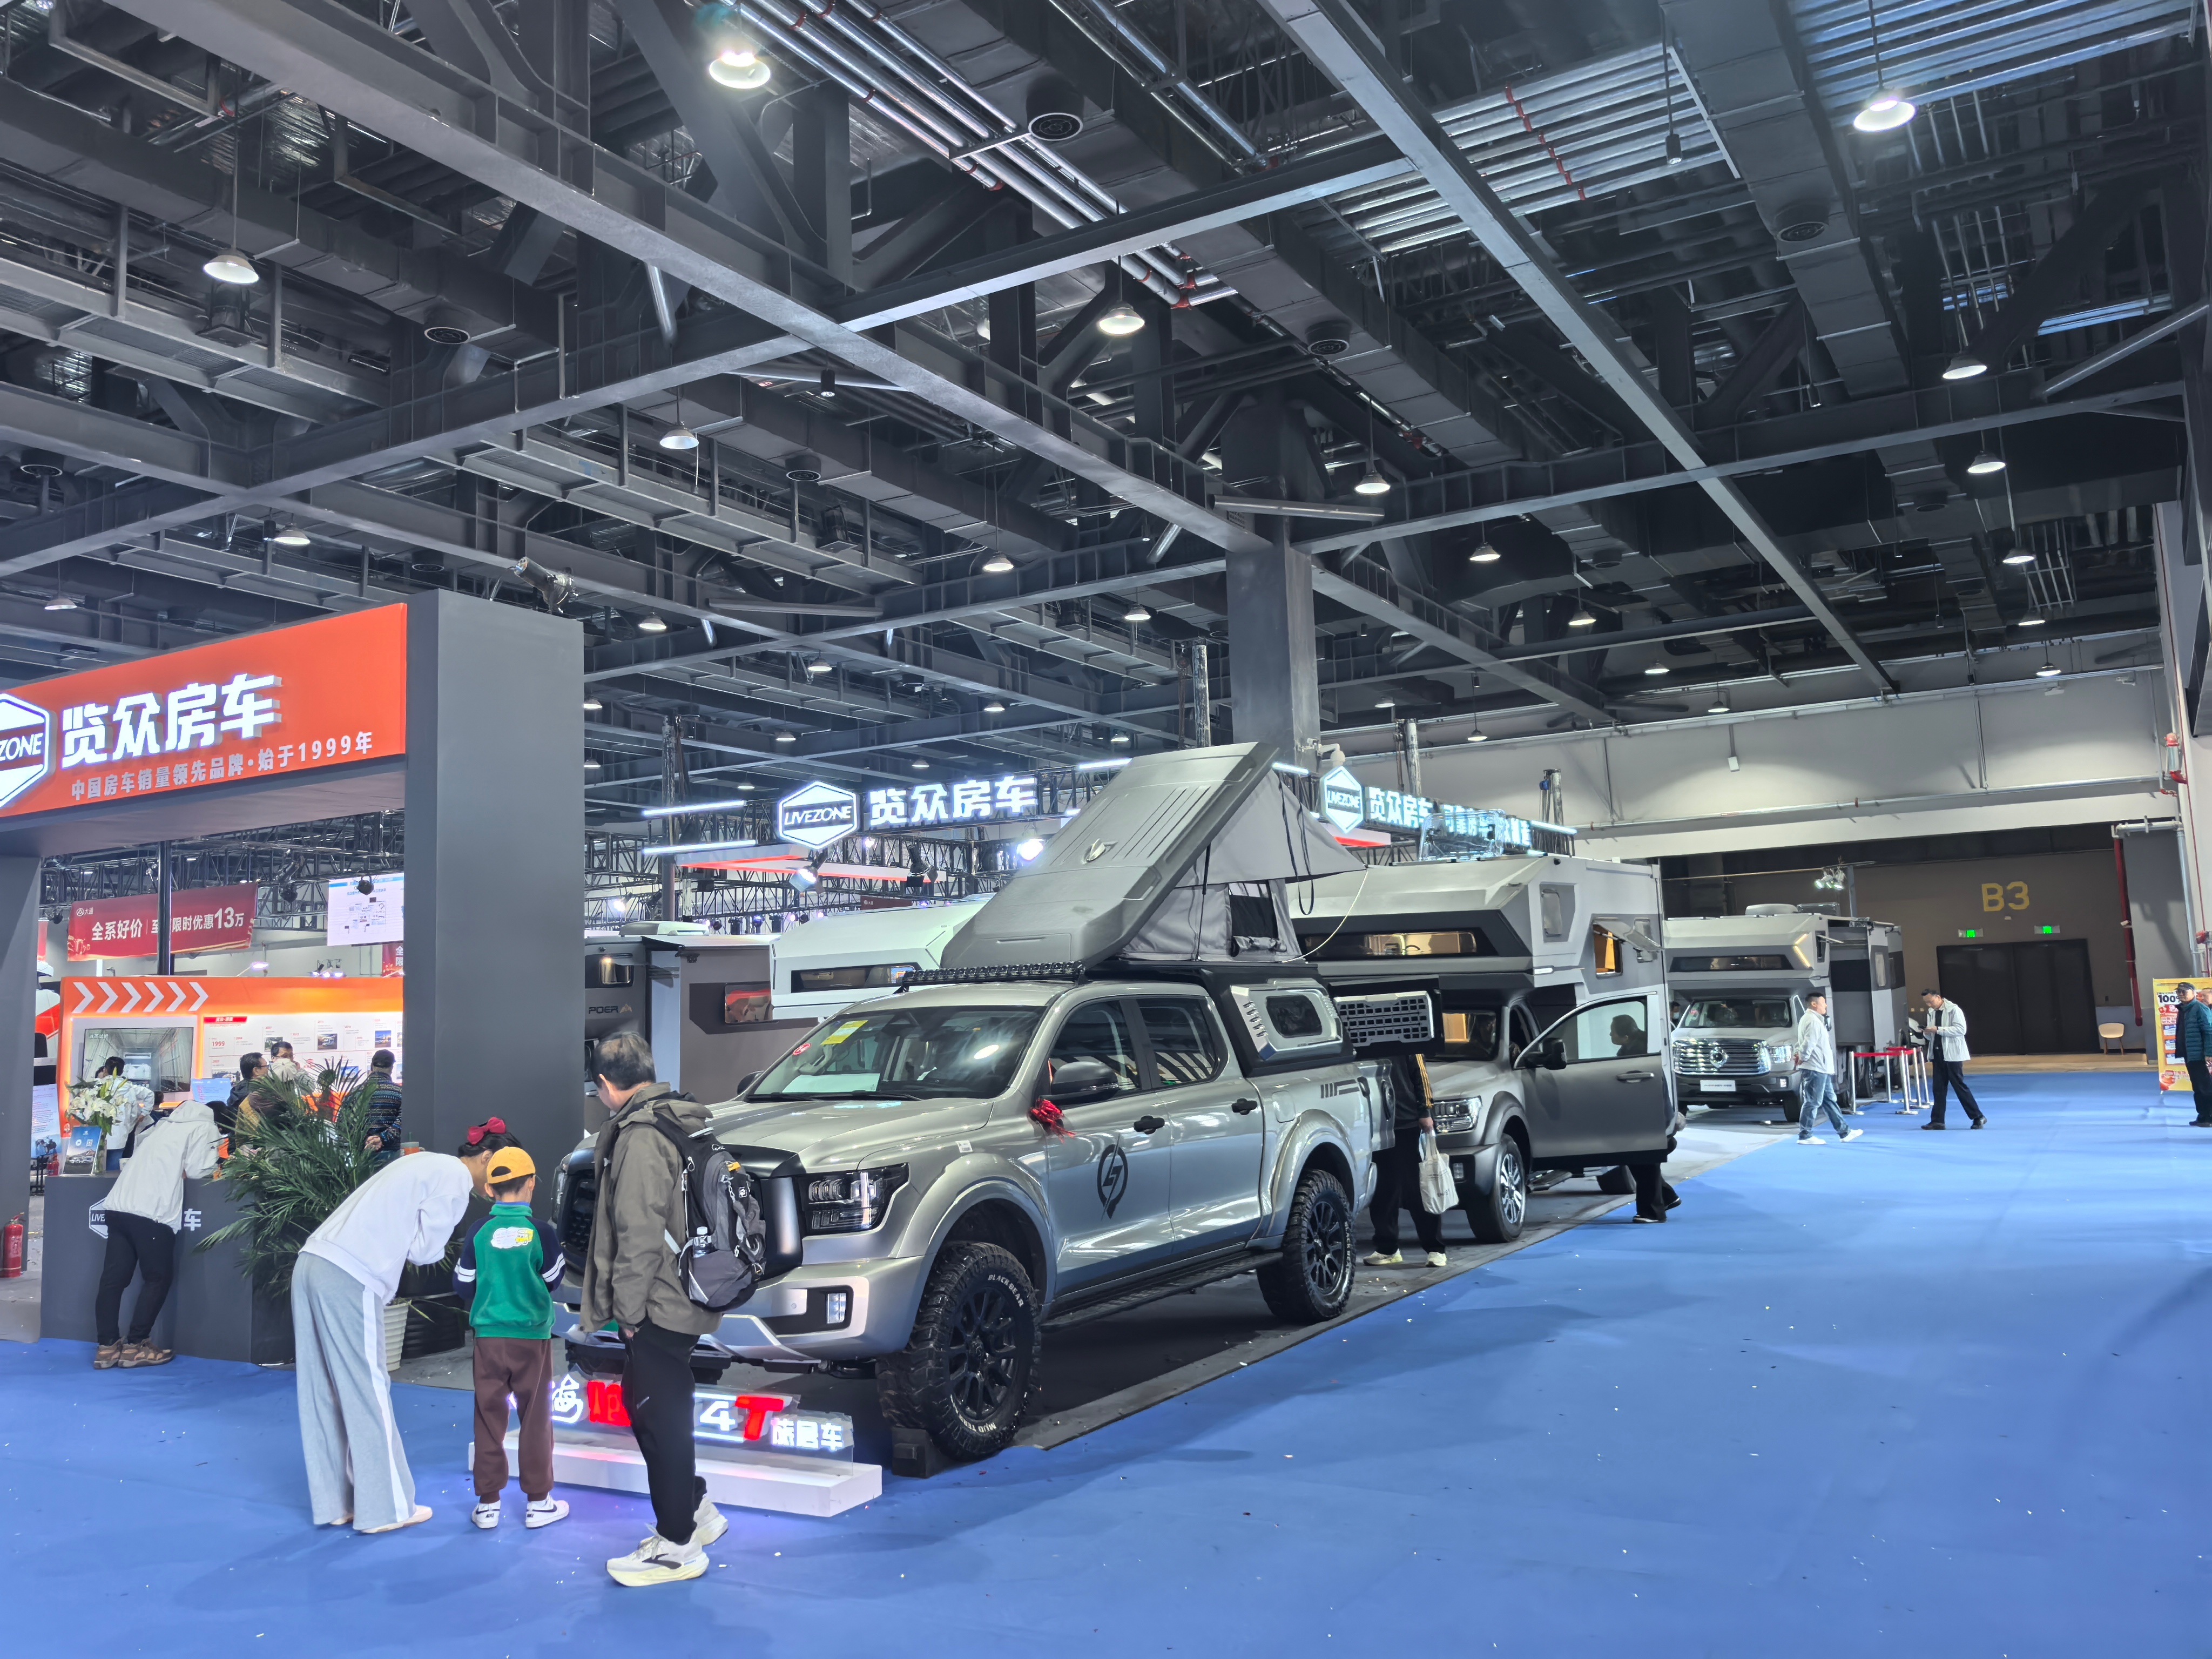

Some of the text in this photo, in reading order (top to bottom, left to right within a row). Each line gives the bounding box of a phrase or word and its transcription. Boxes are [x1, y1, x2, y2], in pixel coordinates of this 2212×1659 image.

[62, 673, 275, 769] 览众房车
[784, 805, 852, 825] LIVEZONE
[869, 775, 1037, 826] 览众房车
[1981, 881, 2029, 912] B3
[91, 907, 245, 941] 全系好价 至限时优惠13万
[588, 1006, 619, 1014] POER
[184, 1209, 202, 1231] 车
